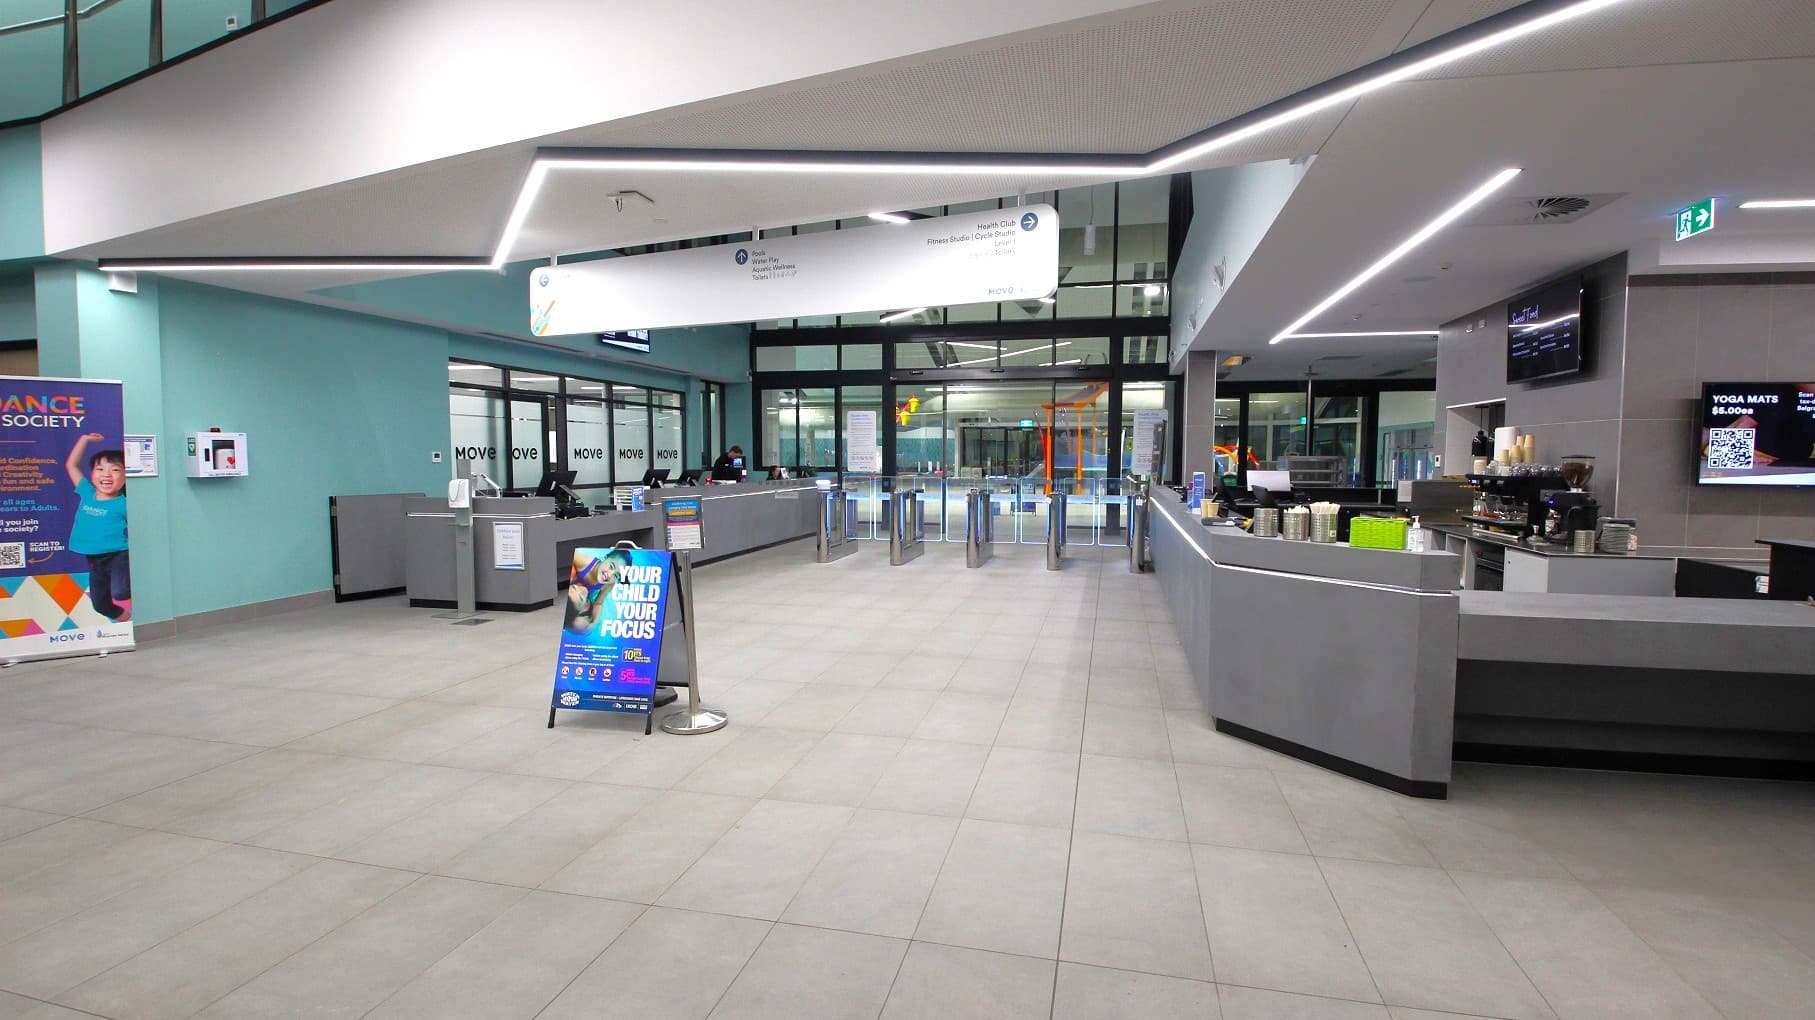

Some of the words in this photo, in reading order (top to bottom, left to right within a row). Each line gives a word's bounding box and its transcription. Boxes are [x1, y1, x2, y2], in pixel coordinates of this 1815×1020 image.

[977, 221, 999, 230] Health
[1000, 219, 1016, 228] Club
[927, 238, 949, 246] Fitness
[949, 234, 970, 243] Studio
[974, 231, 994, 240] Cycle
[994, 230, 1016, 238] Studio
[1712, 394, 1745, 404] YOGA
[1747, 395, 1779, 404] MATS
[1711, 406, 1754, 416] $5.00ea
[1, 414, 85, 428] SOCIETY
[3, 525, 39, 533] society?
[22, 518, 39, 526] join
[619, 565, 663, 583] YOUR
[611, 583, 661, 602] CHILD
[615, 602, 658, 621] YOUR
[600, 619, 656, 640] FOCUS
